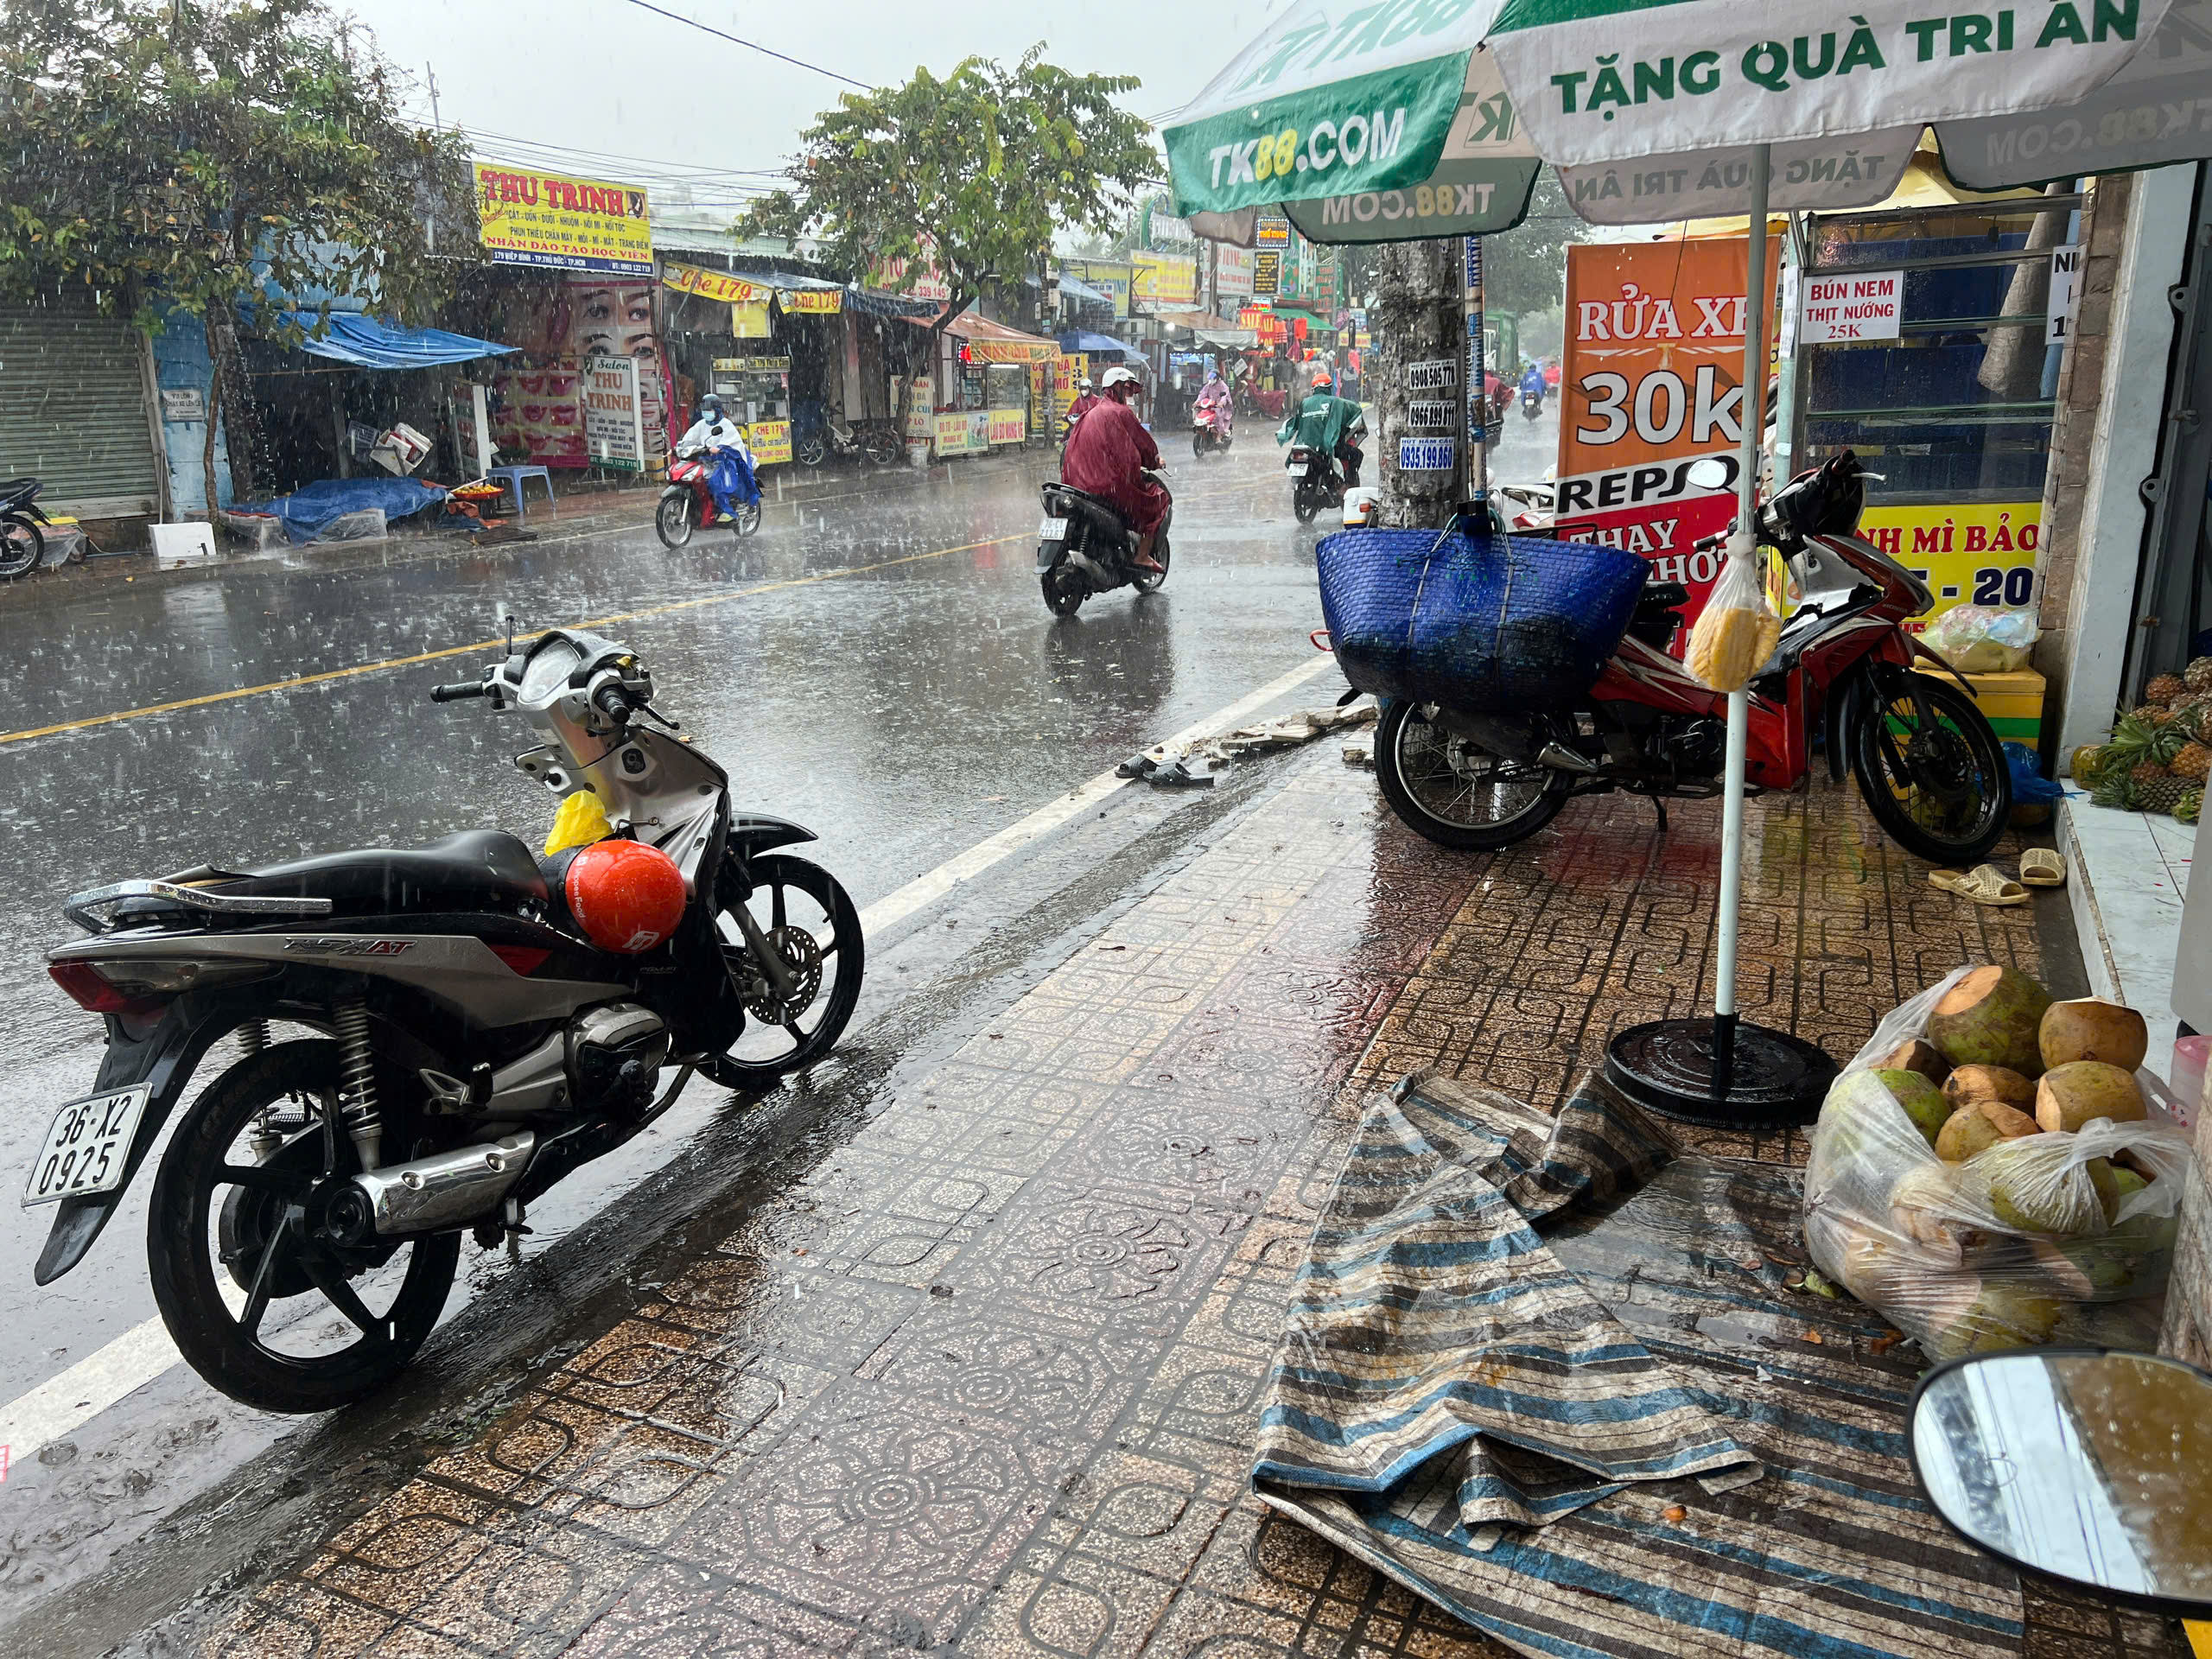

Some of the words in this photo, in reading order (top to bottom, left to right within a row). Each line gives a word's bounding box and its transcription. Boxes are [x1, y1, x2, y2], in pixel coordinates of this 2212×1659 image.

[1551, 50, 1720, 122] TẶNG
[1740, 16, 1887, 92] QUÀ
[1904, 10, 2014, 63] TRI
[1210, 107, 1406, 189] TK88.COM
[480, 169, 537, 206] THU
[544, 180, 625, 217] TRINH
[592, 248, 616, 257] HỌC
[717, 277, 752, 300] 179
[817, 289, 839, 309] 179
[1810, 279, 1848, 301] BÚN
[1854, 279, 1894, 298] NEM
[1577, 283, 1682, 341] RỬA
[1806, 308, 1839, 324] THỊT
[1844, 301, 1894, 320] NƯỚNG
[1827, 323, 1862, 339] 25K
[598, 359, 630, 371] Salon
[594, 372, 623, 389] THU
[1410, 366, 1455, 389] 0908.505.778
[588, 391, 632, 410] TRINH
[1410, 407, 1455, 426] 0966.899.811
[1401, 446, 1452, 468] 0935.199.860
[1911, 518, 1955, 554] MÌ
[1963, 512, 2039, 553] BẢO
[1973, 568, 2034, 607] 20
[55, 1095, 133, 1147] 36-X2
[38, 1141, 117, 1195] 0925
